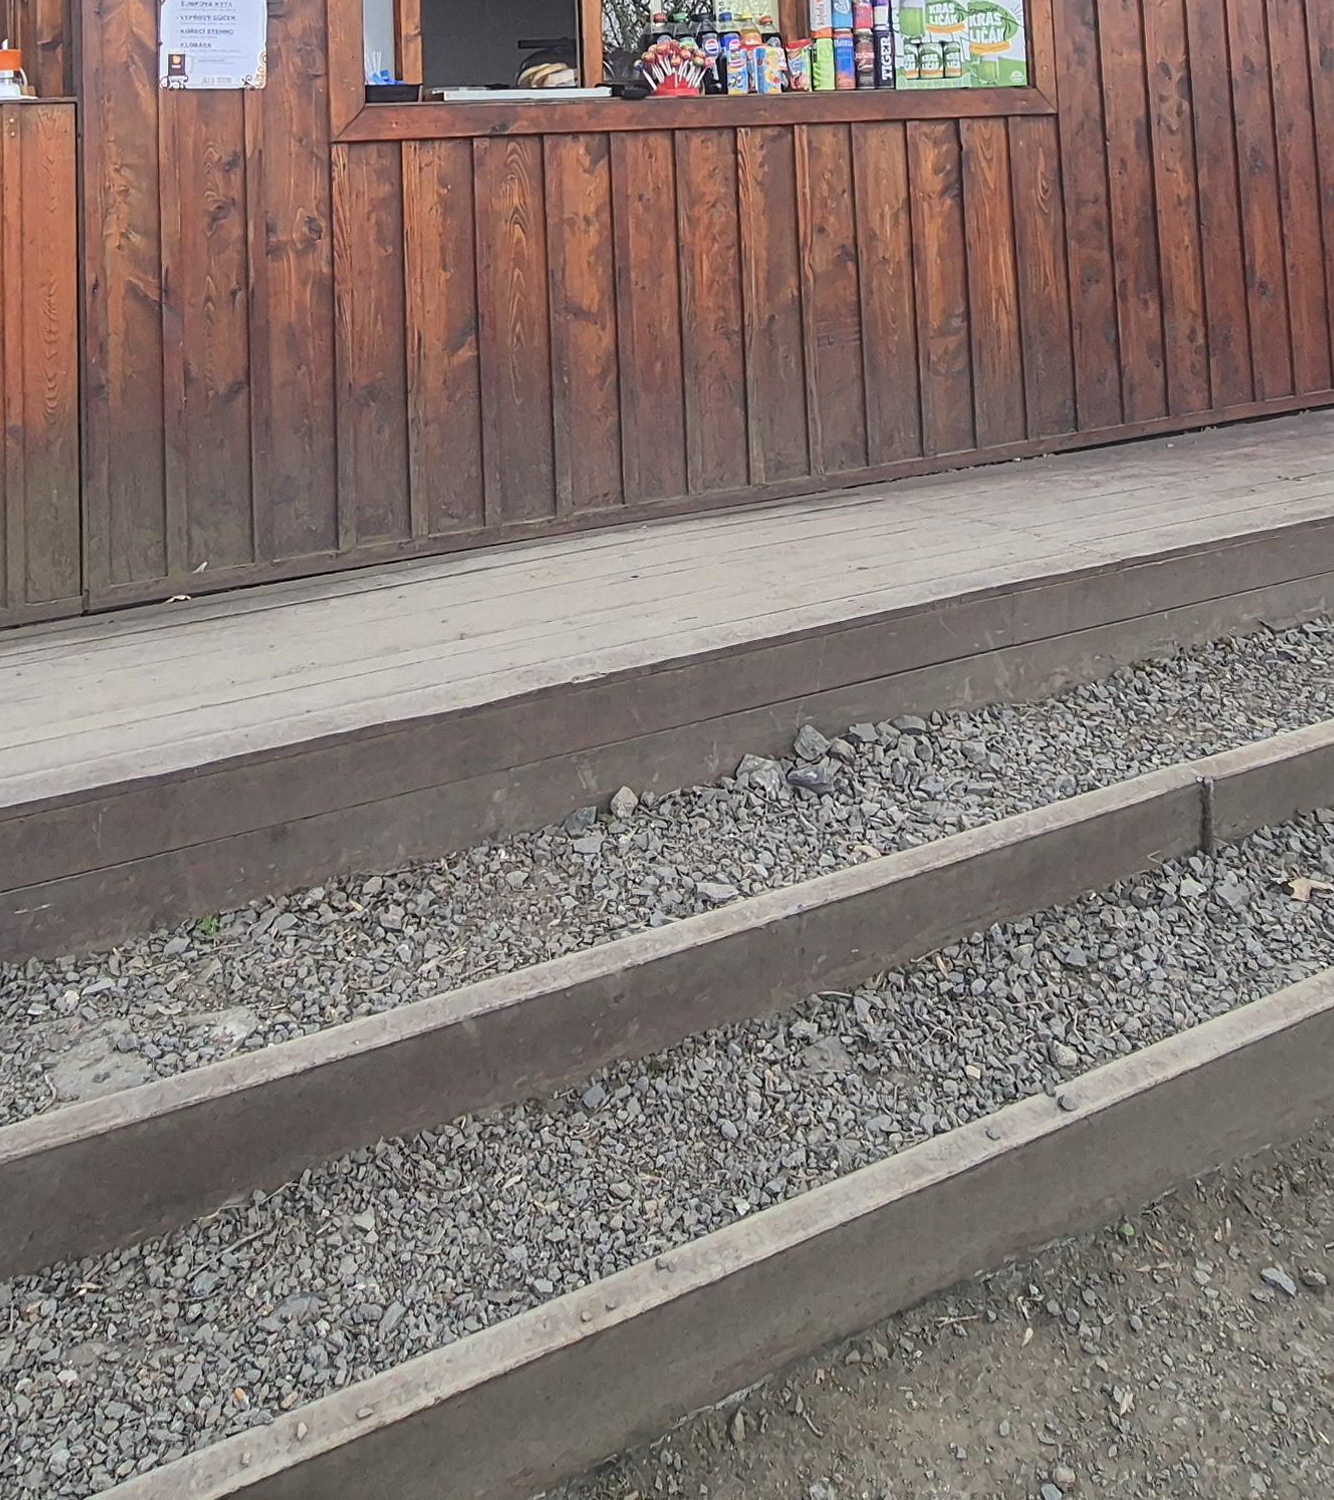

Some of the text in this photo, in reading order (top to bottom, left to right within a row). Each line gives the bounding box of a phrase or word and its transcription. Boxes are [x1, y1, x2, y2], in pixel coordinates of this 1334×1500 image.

[929, 2, 956, 14] KRAS
[969, 11, 1003, 27] KRAS
[880, 35, 893, 80] TIGER
